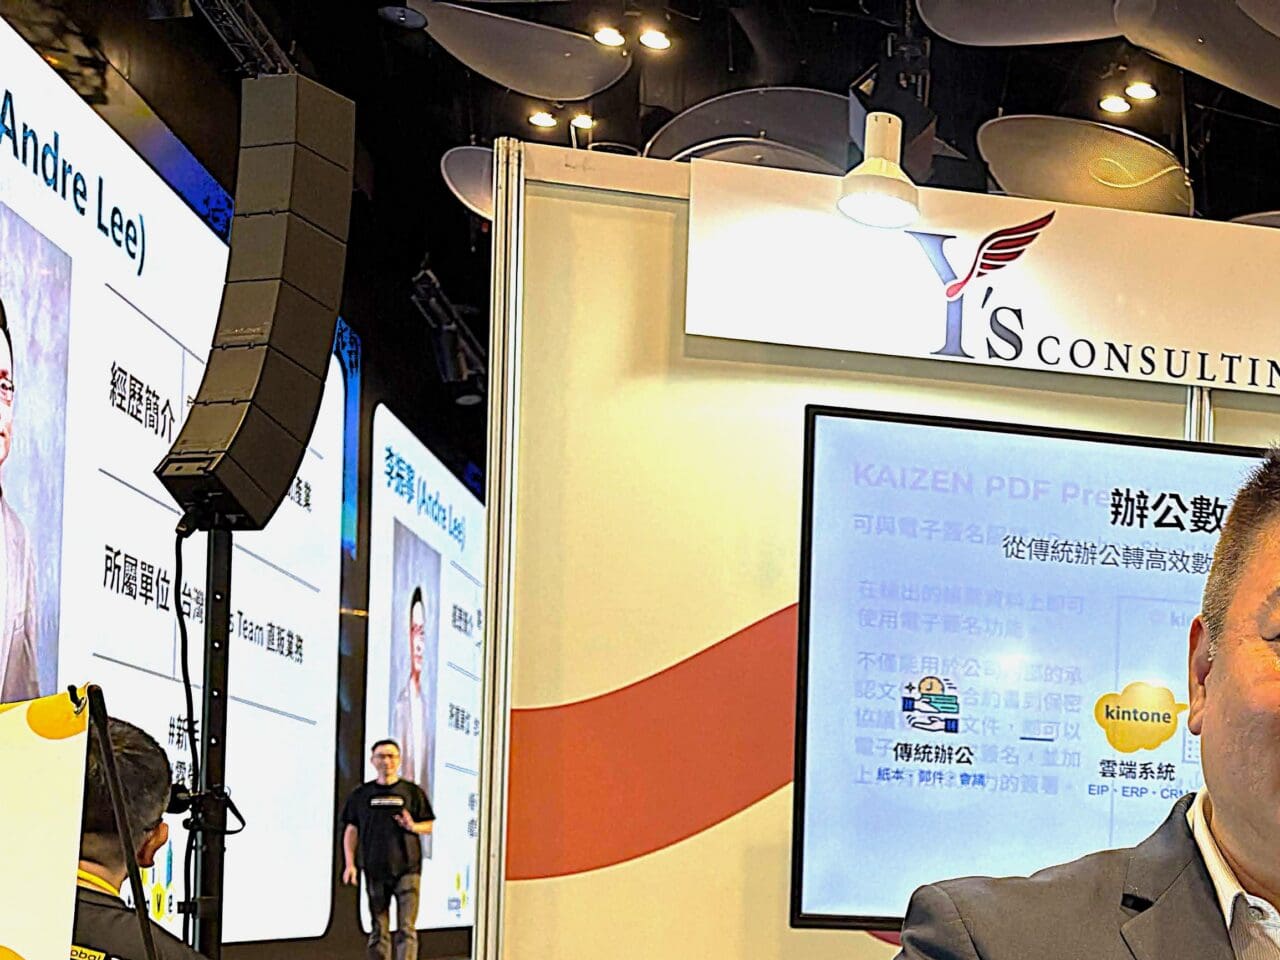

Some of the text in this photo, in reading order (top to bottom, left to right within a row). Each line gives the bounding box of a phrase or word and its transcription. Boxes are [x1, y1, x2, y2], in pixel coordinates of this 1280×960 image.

[0, 89, 145, 276] Andre Lee)
[109, 360, 175, 444] 經歷簡介
[854, 463, 974, 494] KAIZEN
[986, 476, 1052, 500] PDF
[1110, 488, 1227, 534] 辦公數
[1002, 535, 1213, 575] 從傳統辦公轉高效數
[103, 544, 170, 611] 所屬單位
[237, 610, 264, 647] Team
[1105, 705, 1172, 723] kintone
[893, 743, 974, 765] 傳統辦公
[1099, 760, 1175, 781] 雲端系統
